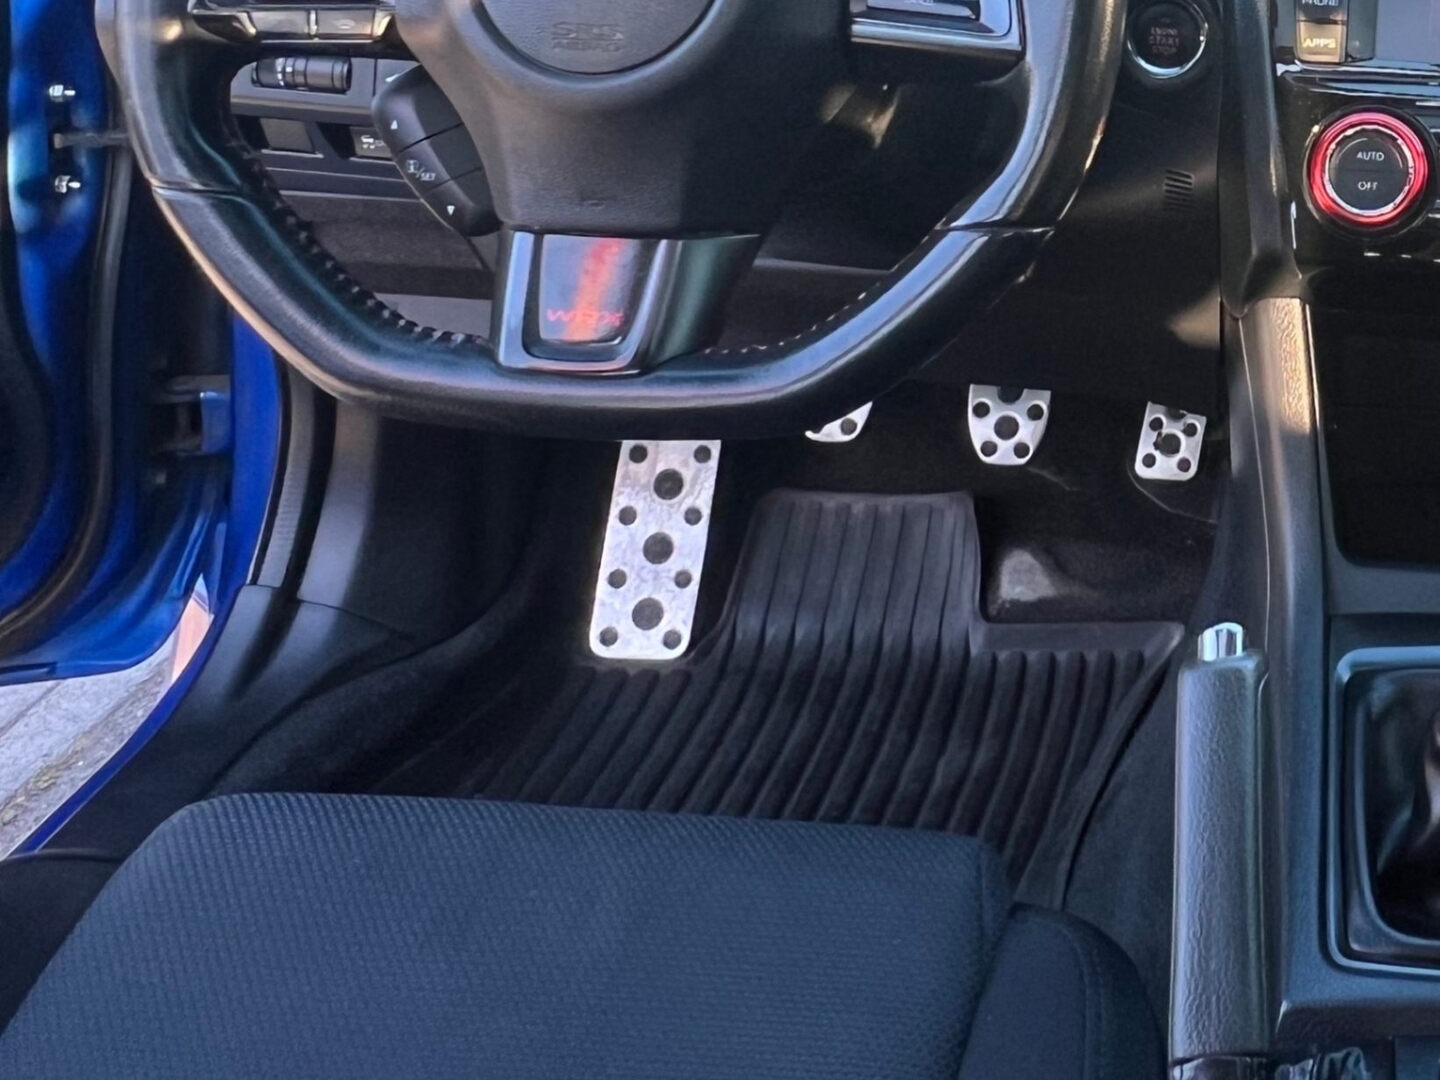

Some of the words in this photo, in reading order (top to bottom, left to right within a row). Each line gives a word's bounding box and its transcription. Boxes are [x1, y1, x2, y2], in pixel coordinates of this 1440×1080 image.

[1302, 37, 1337, 49] APPS
[1356, 151, 1385, 161] AUTO
[1357, 181, 1378, 191] OFF
